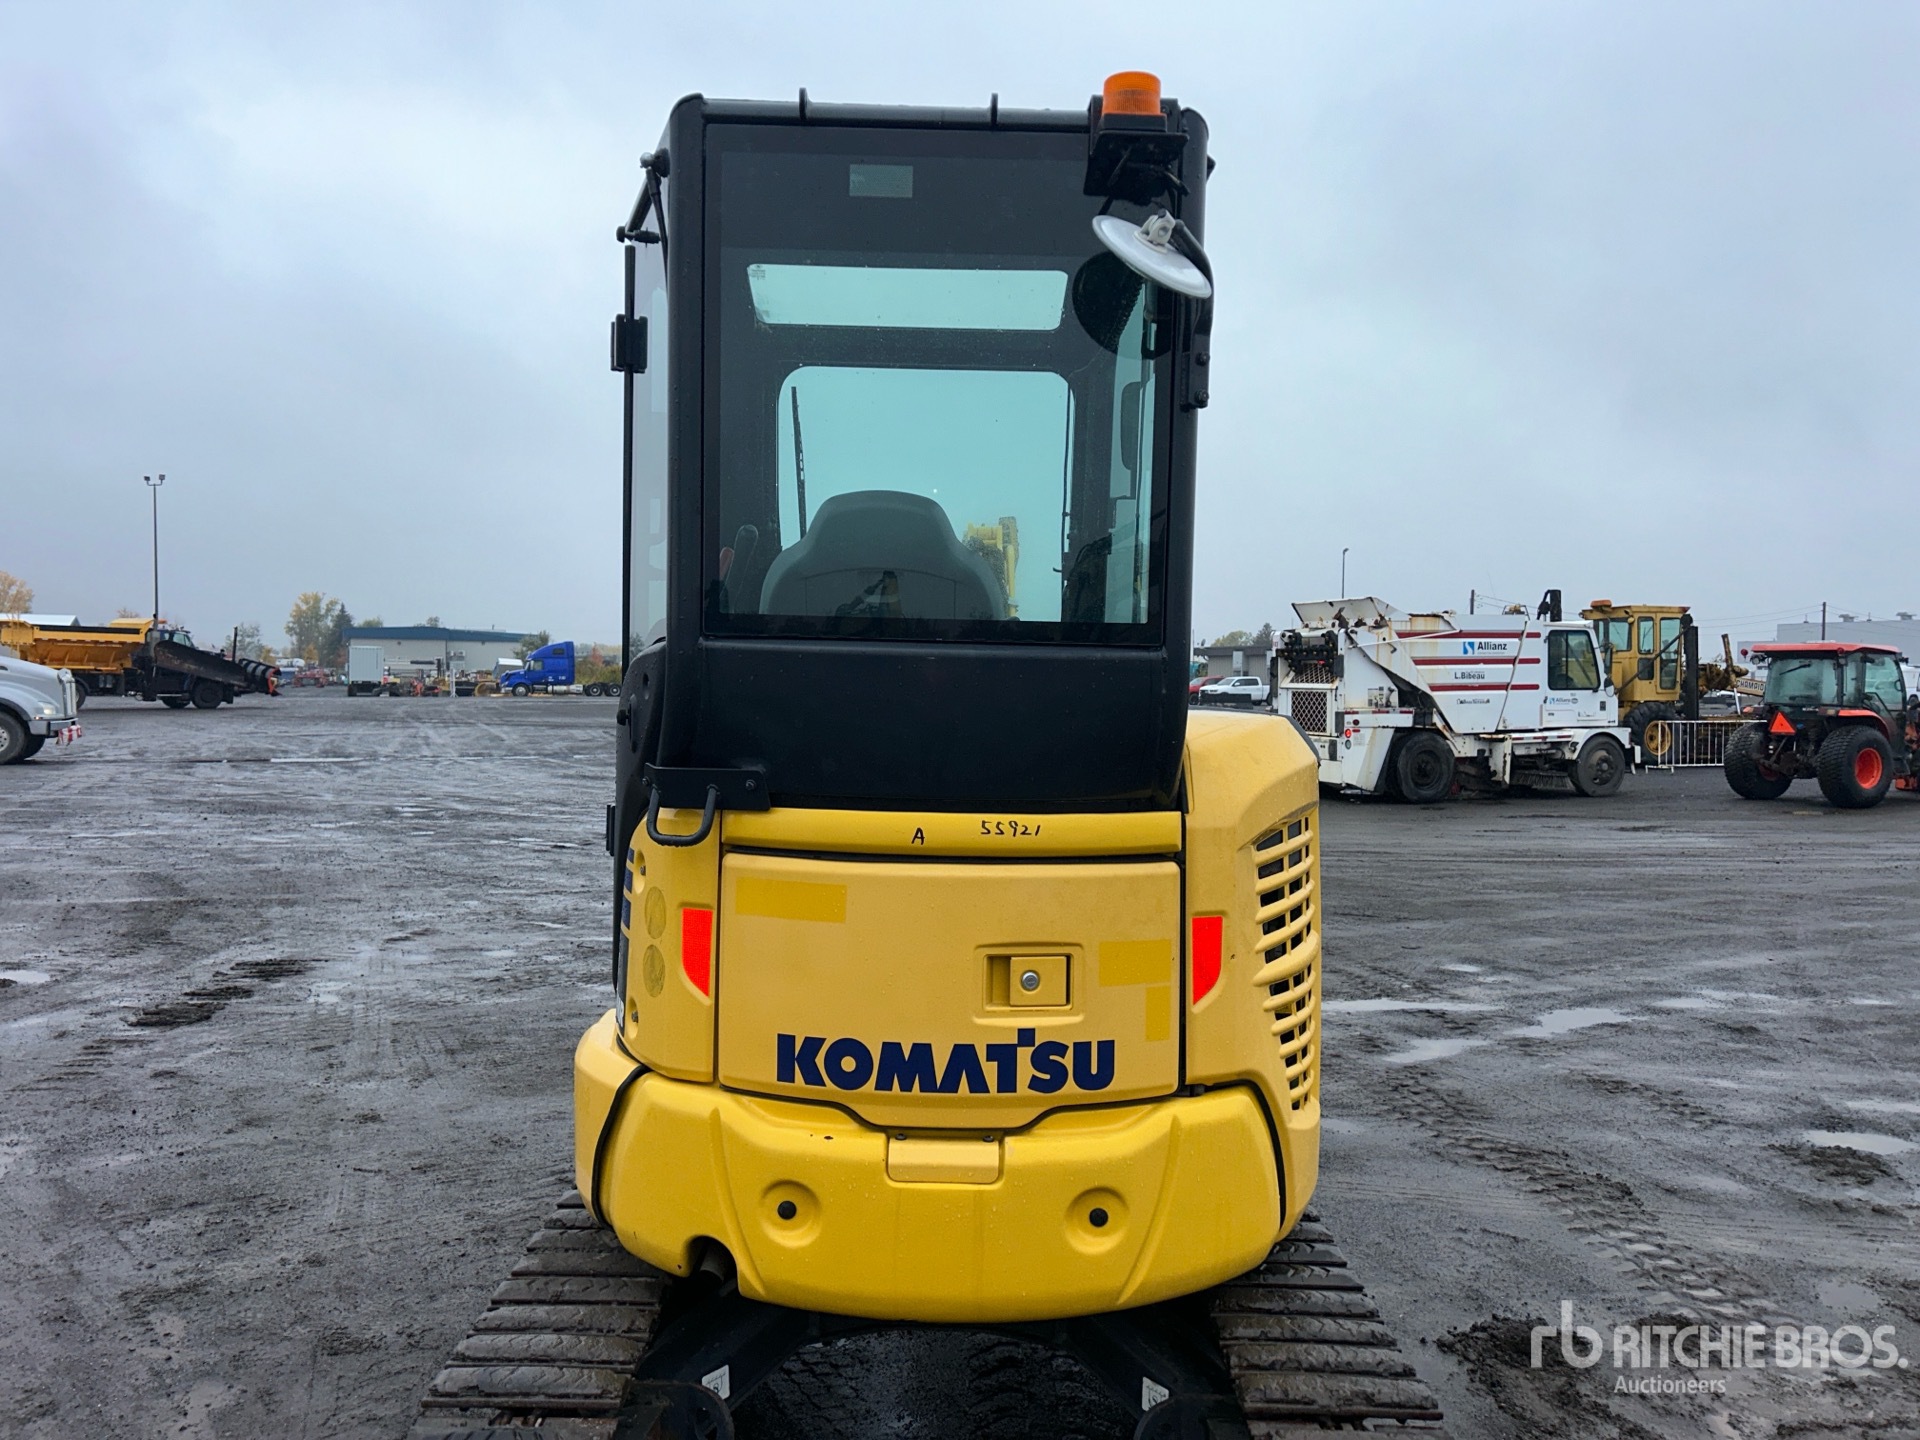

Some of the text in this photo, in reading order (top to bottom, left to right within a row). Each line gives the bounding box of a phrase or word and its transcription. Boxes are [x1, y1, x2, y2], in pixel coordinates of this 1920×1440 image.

[1477, 642, 1508, 651] Allianz
[1454, 671, 1485, 680] L.Bibeau
[1736, 679, 1765, 691] CHAMPIO
[911, 827, 926, 846] A
[776, 1027, 1116, 1094] KOMATSU
